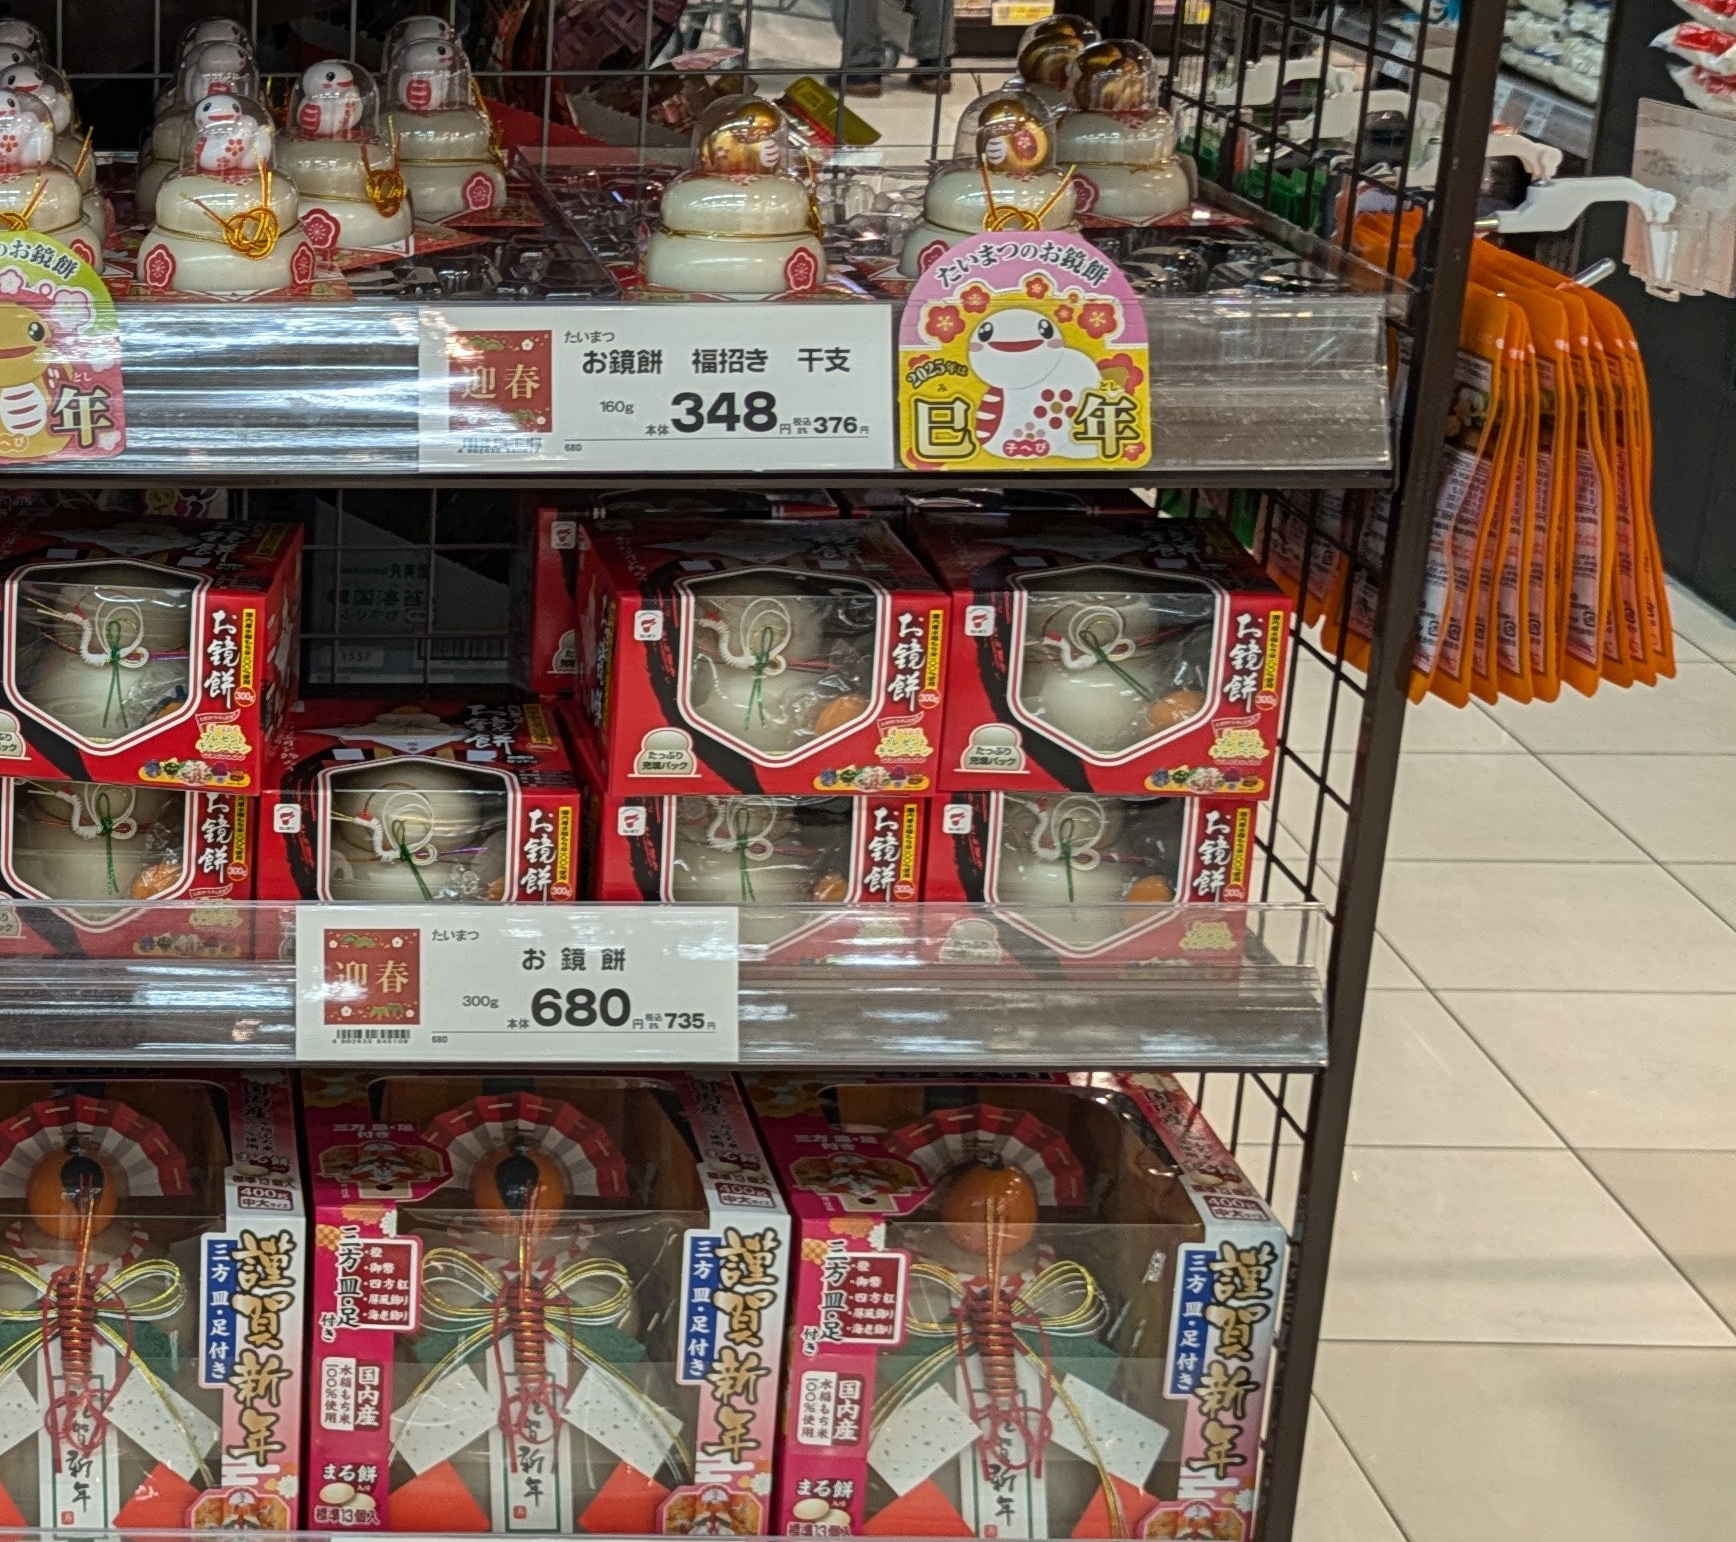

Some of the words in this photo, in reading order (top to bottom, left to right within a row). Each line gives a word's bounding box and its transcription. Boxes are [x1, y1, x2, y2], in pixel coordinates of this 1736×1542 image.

[936, 238, 1110, 287] たいまつのお鏡餅
[564, 330, 615, 343] たいまつ
[582, 349, 663, 375] お鏡餅
[692, 349, 768, 374] 福招き
[797, 348, 851, 372] 干支
[461, 365, 540, 399] 迎春
[52, 387, 111, 448] 年
[600, 401, 634, 415] 160g
[671, 392, 777, 434] 348
[1070, 393, 1141, 457] 年
[203, 610, 240, 708] お鏡餅
[431, 929, 479, 941] たいまつ
[334, 960, 409, 994] 迎春
[462, 995, 498, 1008] 300g
[531, 988, 631, 1028] 680
[1186, 1241, 1278, 1480] 謹賀新年
